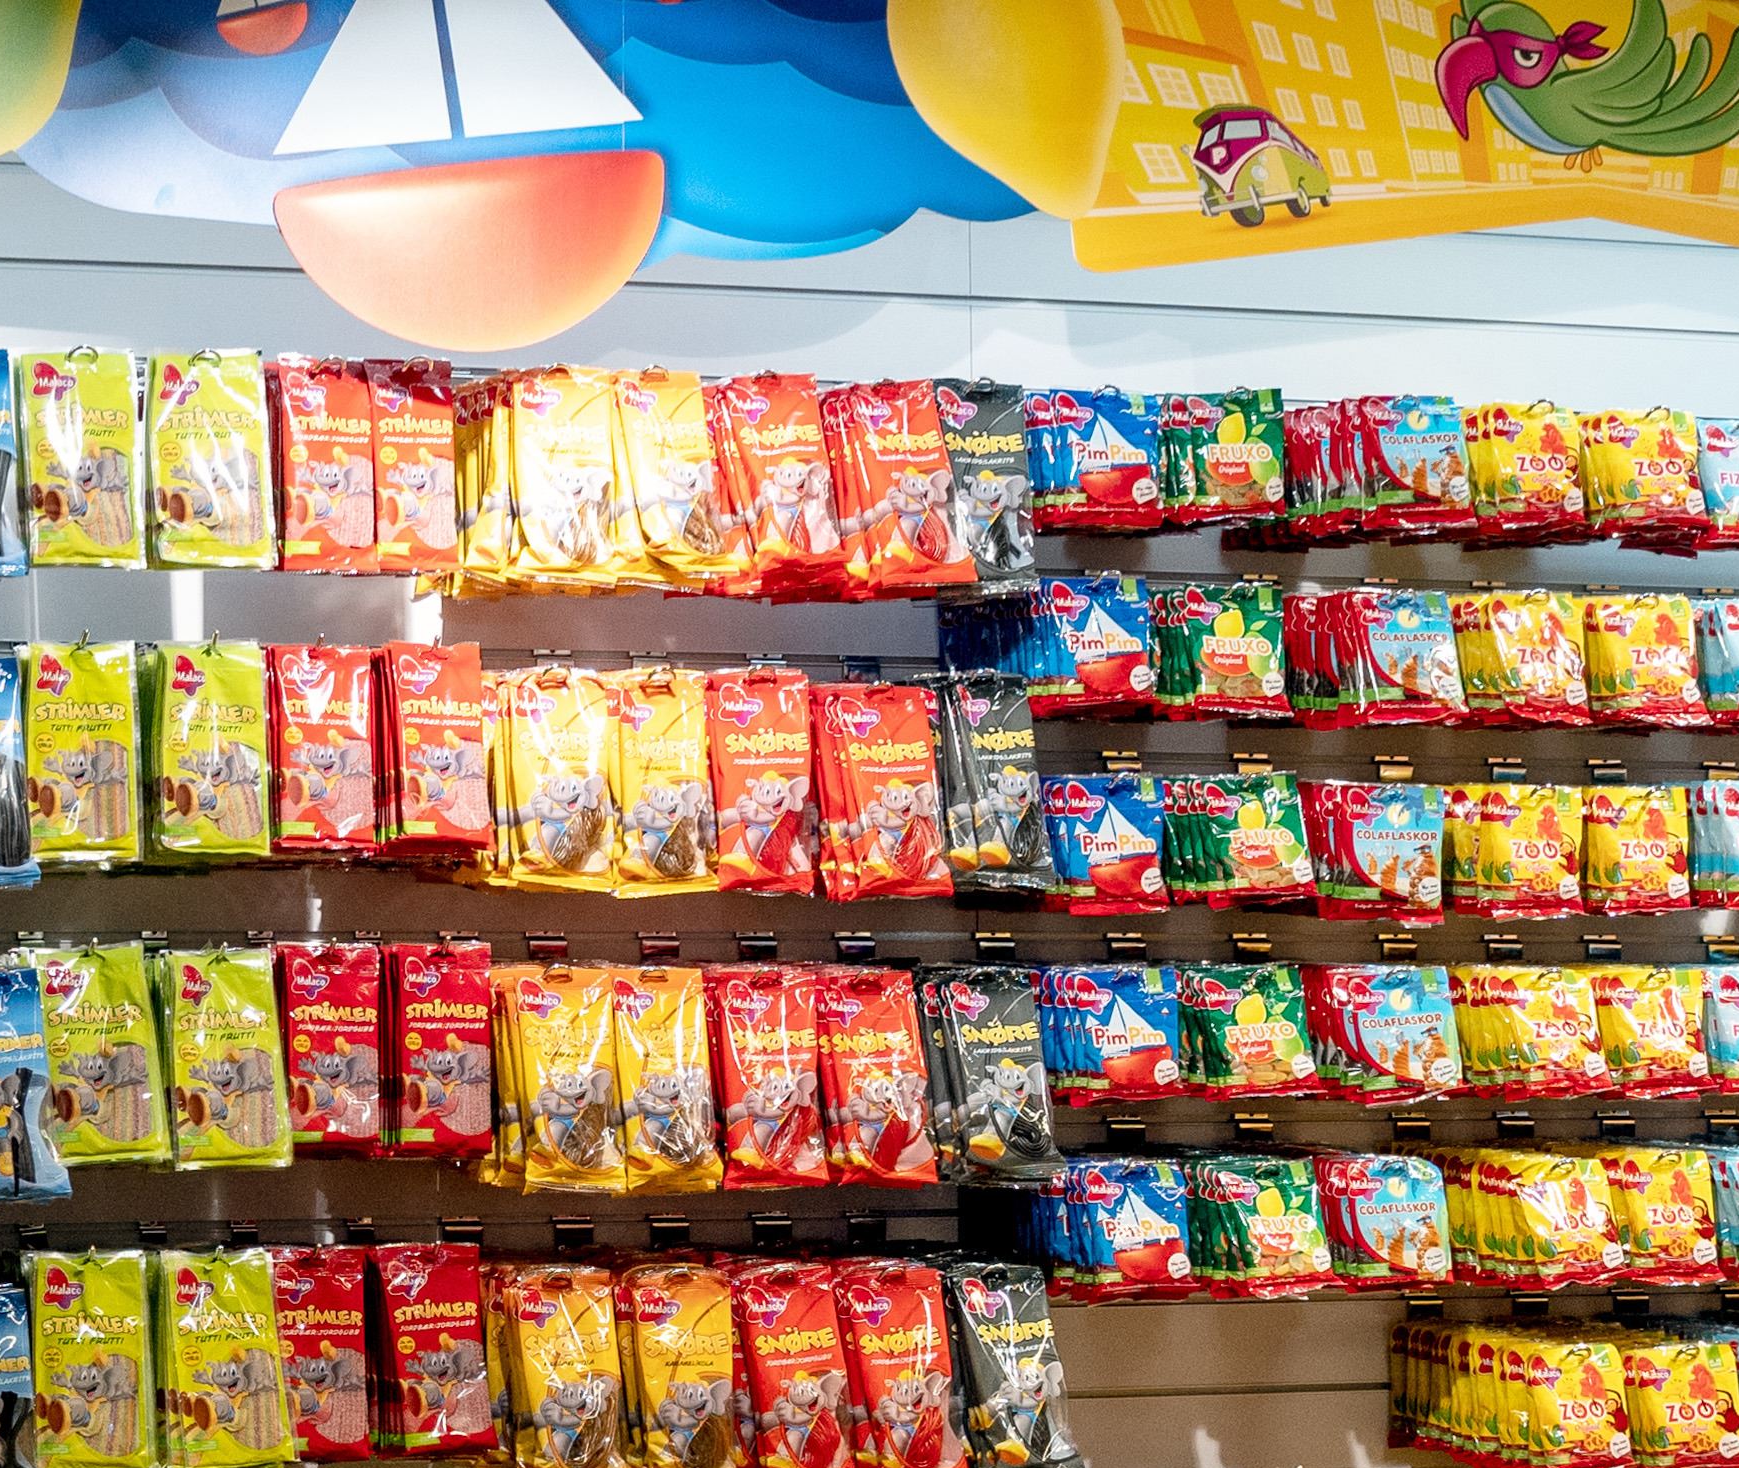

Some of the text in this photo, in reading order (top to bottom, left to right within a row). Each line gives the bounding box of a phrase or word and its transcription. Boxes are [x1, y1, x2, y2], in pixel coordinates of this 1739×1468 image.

[1382, 434, 1459, 446] COLAFLASKOR
[1073, 441, 1146, 462] PimPim
[1208, 444, 1271, 461] FRUXO
[50, 723, 112, 733] TUTTI FRUTTI
[1080, 834, 1156, 854] PimPim
[1510, 839, 1556, 860] ZOO
[1361, 1012, 1443, 1029] COLAFLASKOR
[1093, 1025, 1166, 1047] PimPim
[1226, 1023, 1295, 1042] FRUXO
[1358, 1202, 1436, 1214] COLAFLASKOR
[1558, 1400, 1606, 1423] ZOO
[1664, 1400, 1714, 1425] ZOO
